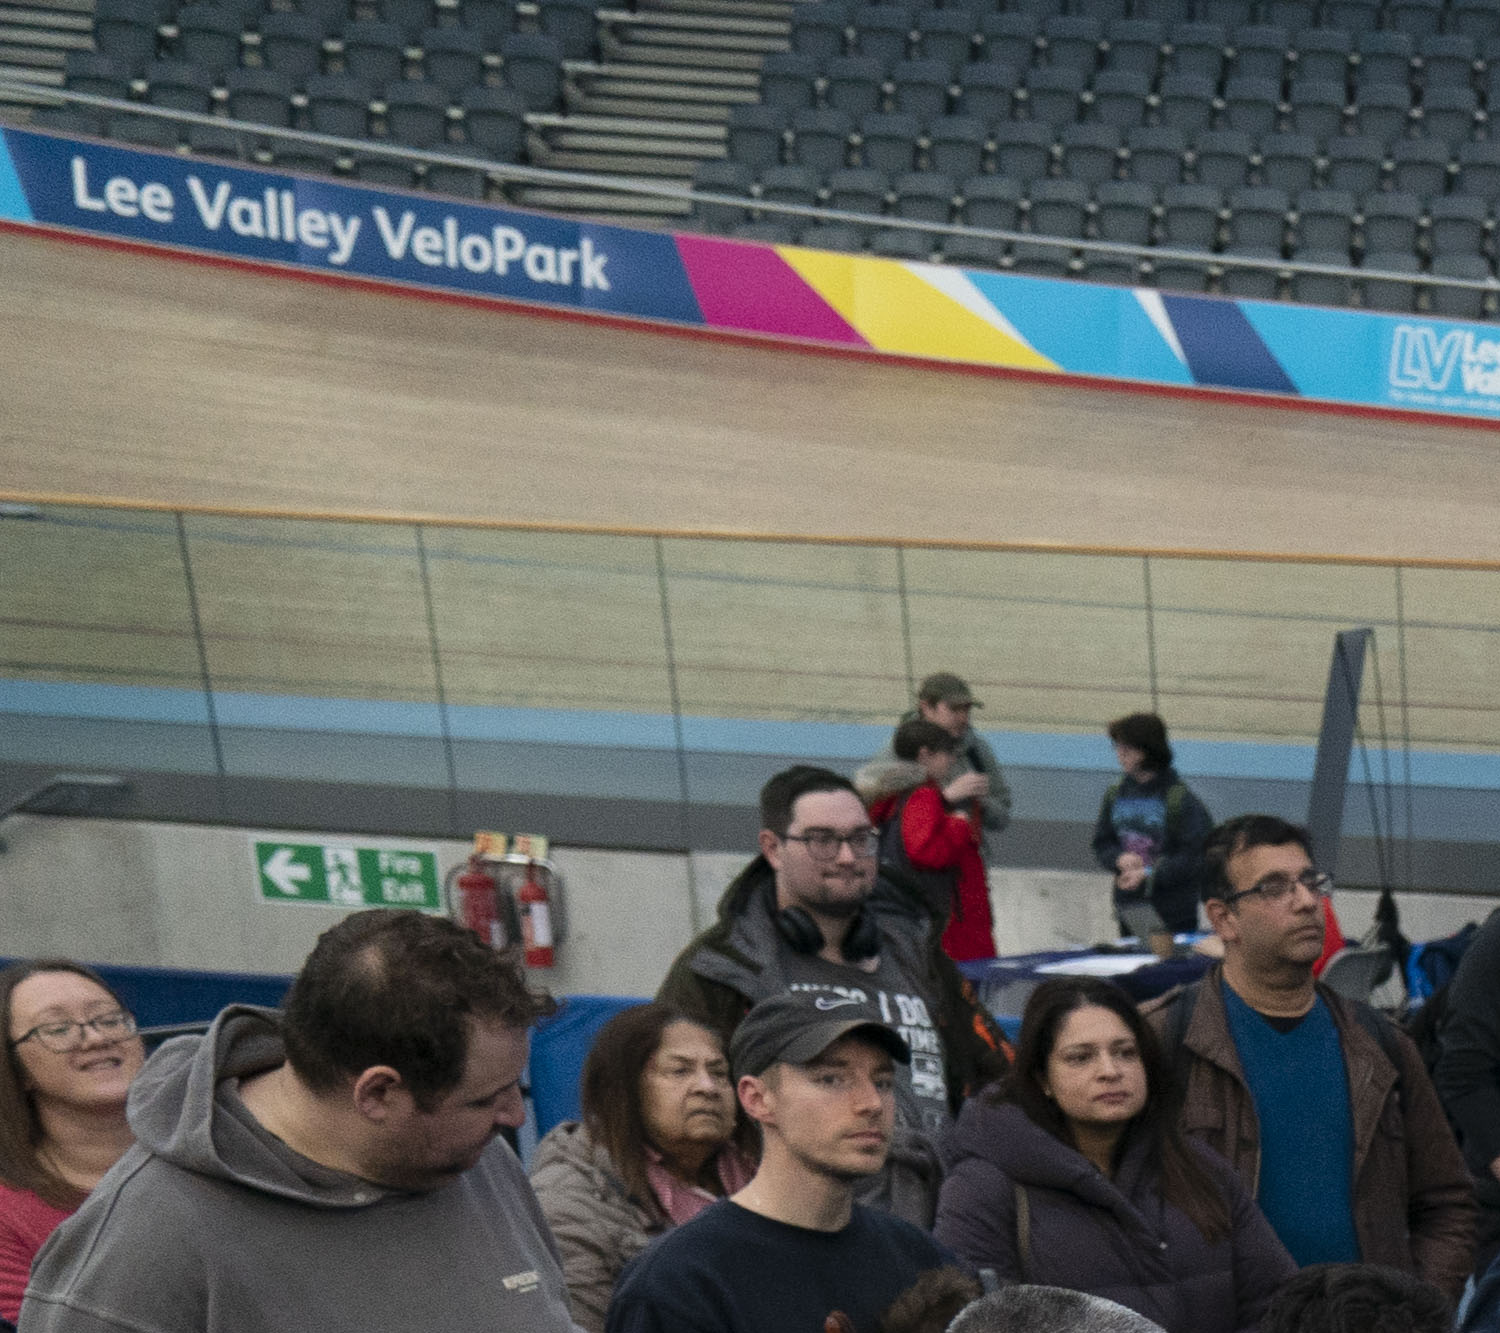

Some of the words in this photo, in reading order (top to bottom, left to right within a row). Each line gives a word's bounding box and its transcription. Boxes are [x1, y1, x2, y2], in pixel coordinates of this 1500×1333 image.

[70, 156, 174, 223] Lee
[186, 176, 361, 265] Valley
[373, 207, 611, 290] VeloPark
[378, 850, 423, 874] Fire
[382, 876, 426, 903] Exit
